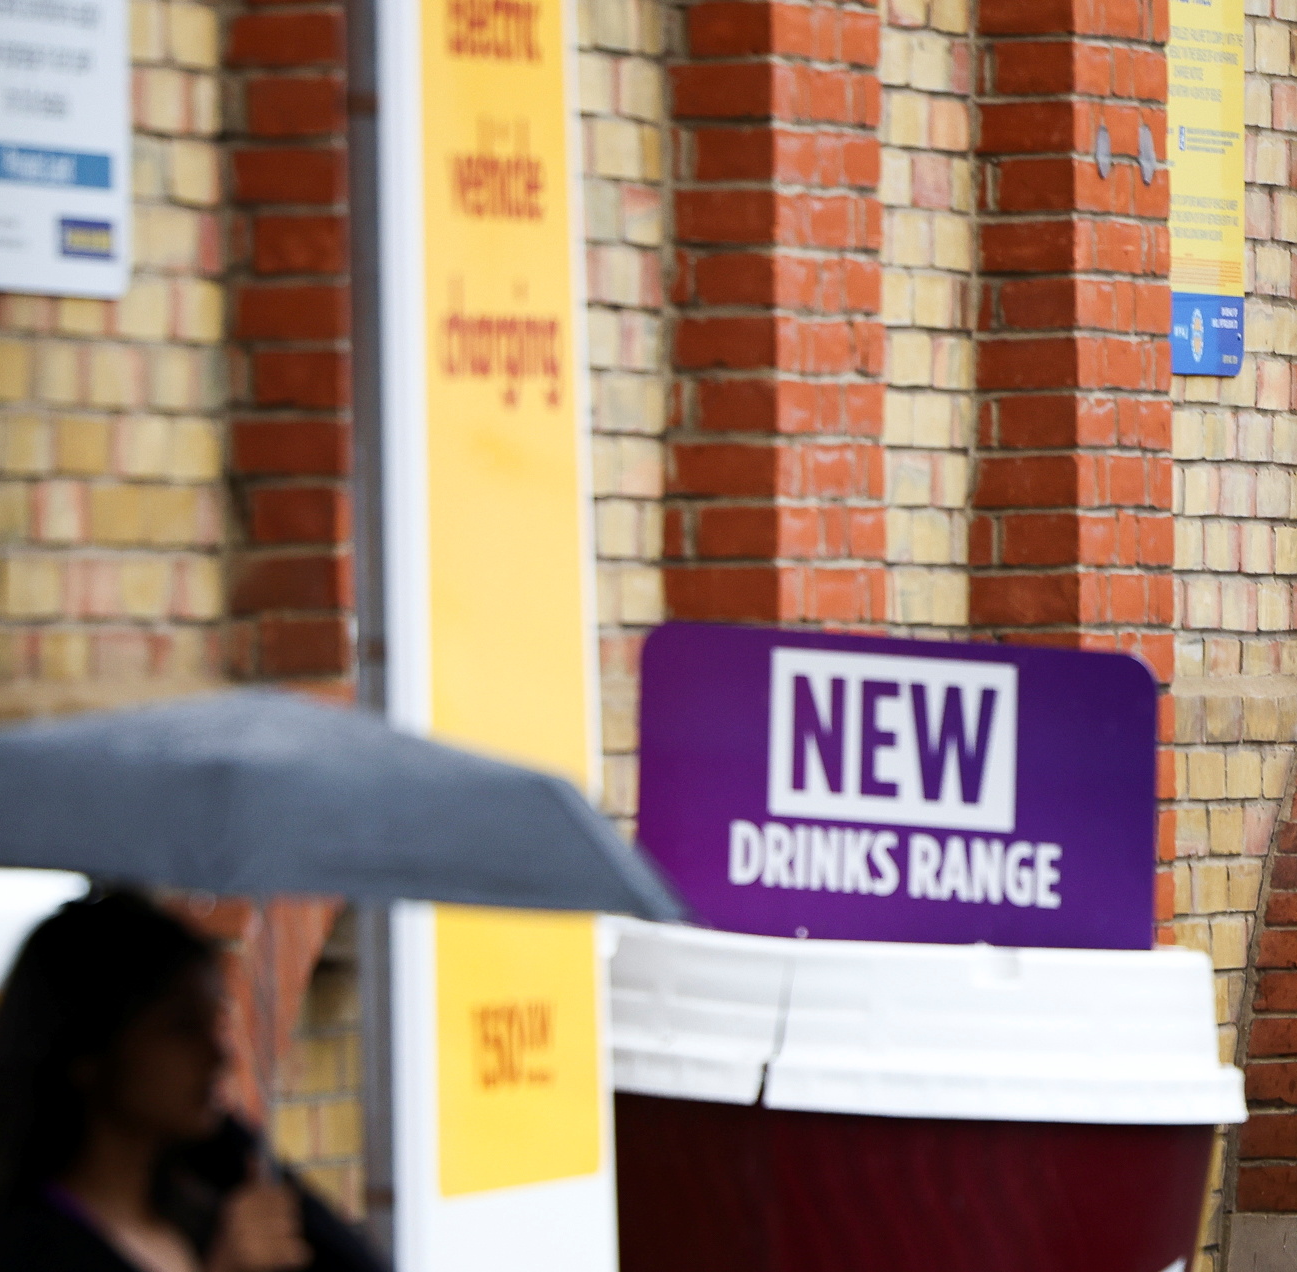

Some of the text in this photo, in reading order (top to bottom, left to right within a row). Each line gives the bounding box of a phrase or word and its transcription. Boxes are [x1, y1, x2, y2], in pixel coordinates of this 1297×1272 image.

[791, 674, 1000, 806] NEW
[729, 818, 1062, 909] DRINKS RANGE
